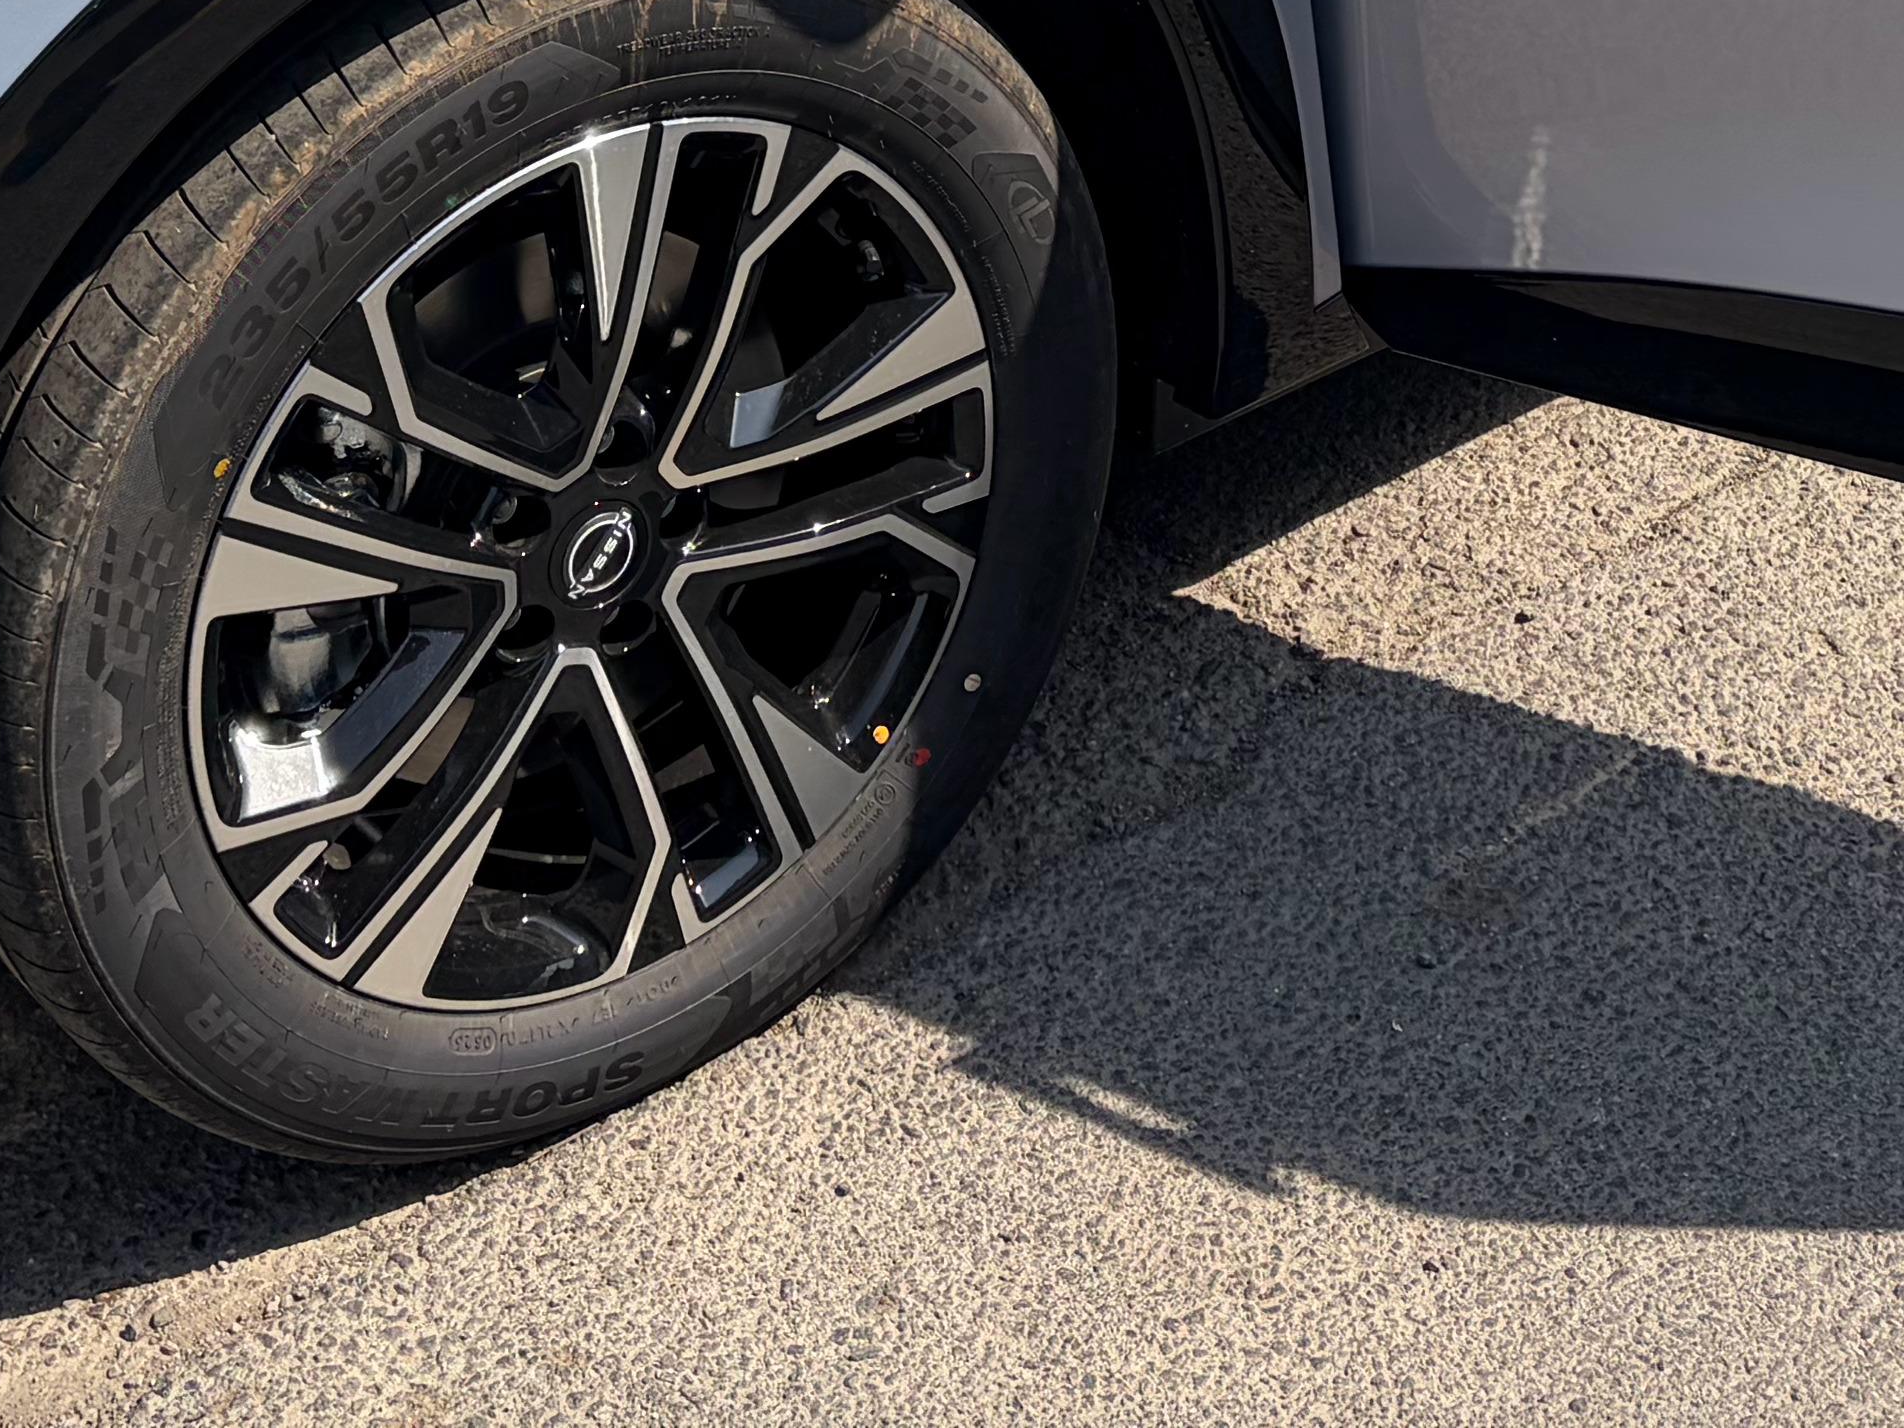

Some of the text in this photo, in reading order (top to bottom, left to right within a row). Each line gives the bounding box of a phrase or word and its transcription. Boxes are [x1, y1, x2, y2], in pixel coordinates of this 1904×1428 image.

[196, 80, 530, 412] 235/55R19
[567, 507, 633, 600] NISSAN
[182, 991, 648, 1130] SPORT MASTER
